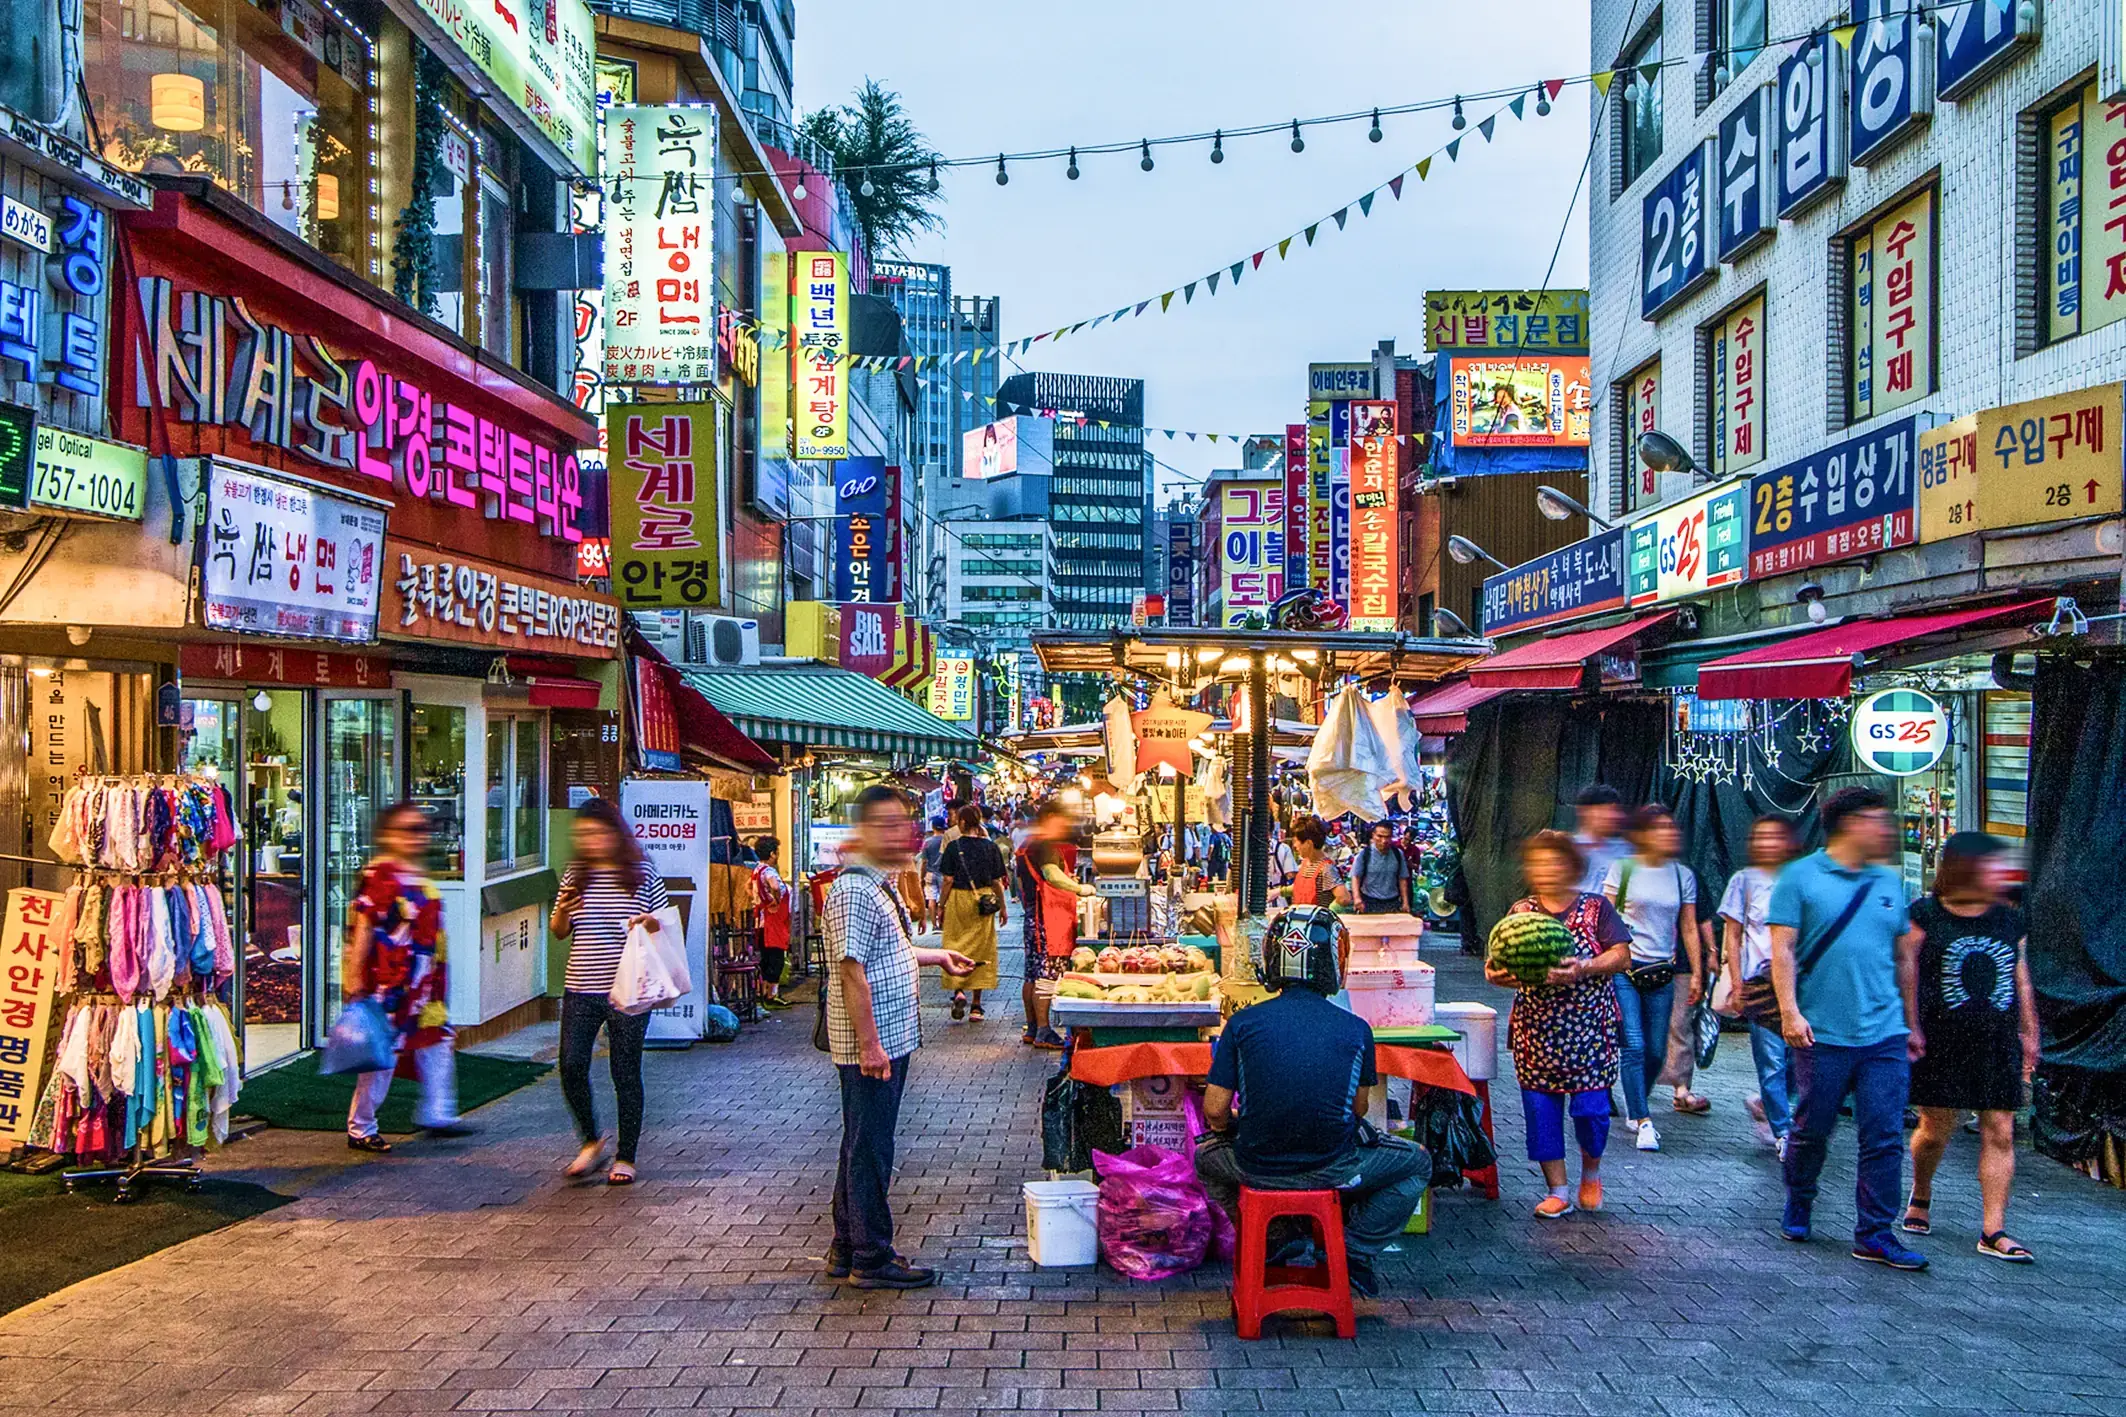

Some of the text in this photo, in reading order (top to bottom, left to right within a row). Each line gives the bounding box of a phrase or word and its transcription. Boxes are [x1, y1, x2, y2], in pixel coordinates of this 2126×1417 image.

[47, 137, 83, 169] Optical
[101, 166, 142, 200] 757-1004
[5, 205, 48, 246] めがね
[618, 188, 637, 222] 주는
[618, 226, 634, 278] 냉면집
[615, 309, 639, 327] 2F
[809, 283, 836, 329] 백년
[1886, 219, 1917, 394] 수입구제
[1432, 313, 1582, 347] 신발전문점
[1312, 369, 1371, 392] 이비인후과
[1733, 316, 1756, 456] 수입구제
[58, 434, 94, 460] Optical
[799, 446, 846, 456] 310-9950
[814, 426, 831, 437] 2F
[1641, 376, 1656, 496] 수입제
[1994, 404, 2105, 470] 수입구제
[35, 461, 137, 515] 757-1004
[624, 414, 701, 551] 세계로
[1799, 429, 1909, 524] 수입상가
[2045, 486, 2073, 507] 2층
[213, 507, 337, 597] 육쌈냉면
[1659, 508, 1705, 582] GS25
[621, 560, 710, 603] 안경
[855, 609, 883, 634] BIG
[849, 630, 888, 657] SALE
[48, 714, 65, 765] 만드는
[1869, 718, 1937, 745] GS25
[633, 803, 699, 820] 아메리카노
[634, 822, 698, 841] 2,500원
[0, 895, 53, 1030] 천사안경
